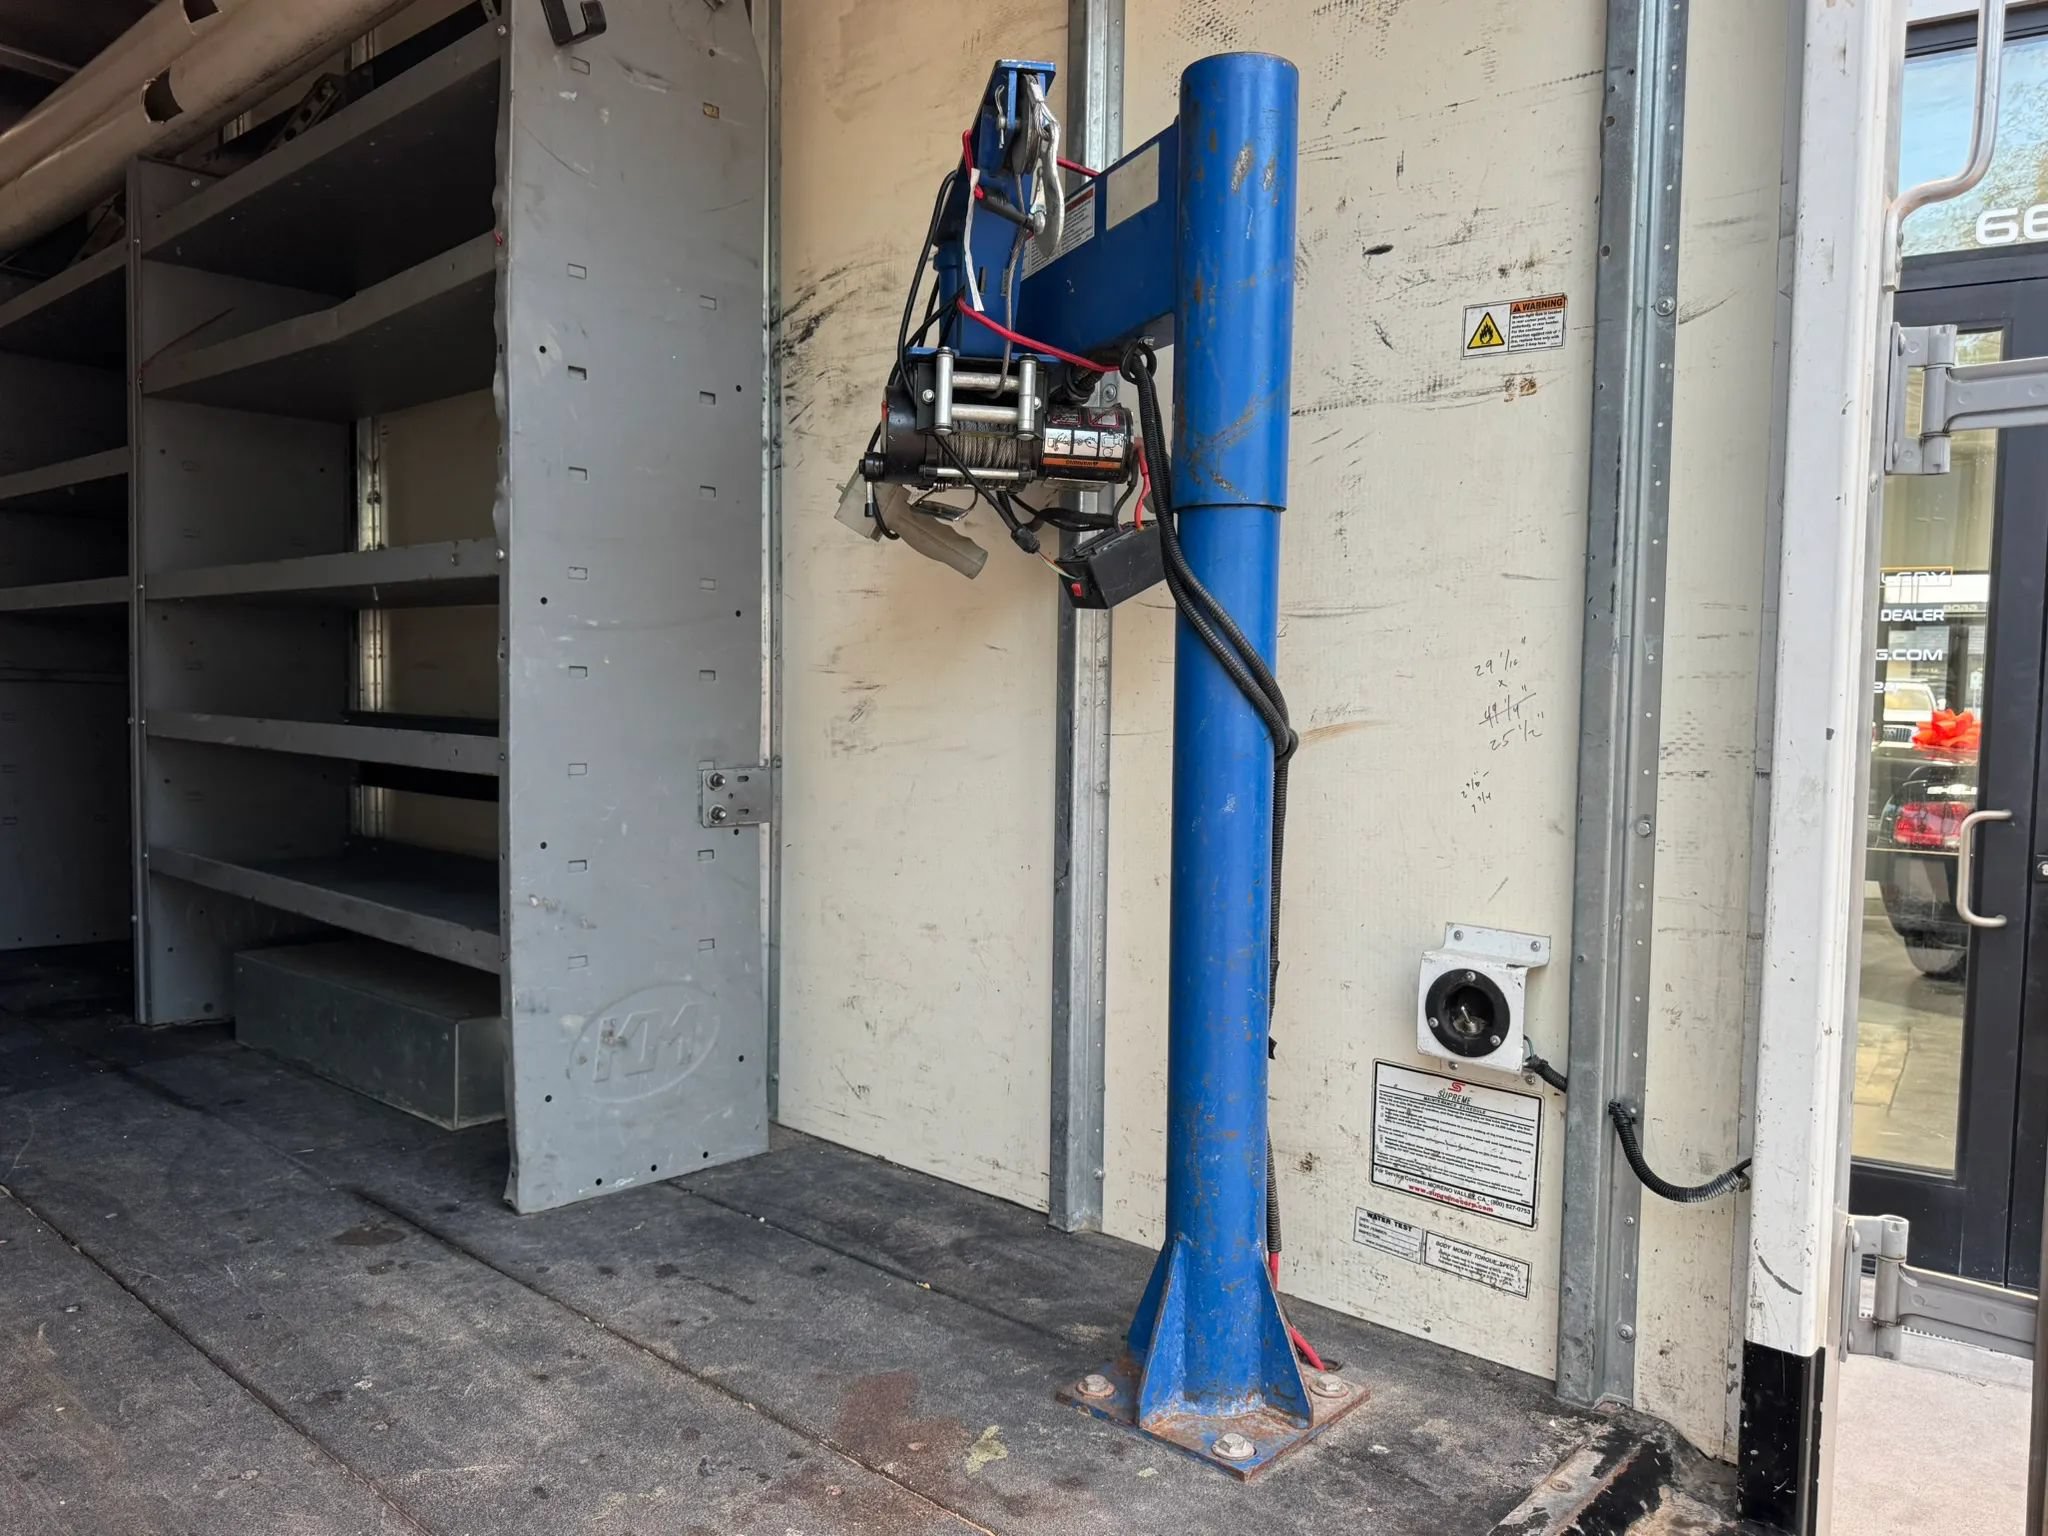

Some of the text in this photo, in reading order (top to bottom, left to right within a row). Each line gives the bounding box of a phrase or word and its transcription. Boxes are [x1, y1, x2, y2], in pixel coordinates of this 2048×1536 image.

[1522, 298, 1563, 311] WARNING
[1880, 608, 1945, 622] DEALER
[1474, 659, 1493, 677] 29
[1437, 1087, 1472, 1105] SUPREME
[1404, 1175, 1426, 1185] Contact:
[1427, 1181, 1452, 1193] MORENO
[1366, 1212, 1412, 1232] WATER TEST
[1435, 1240, 1518, 1272] BODY MOUNT TORQUE SPECS
